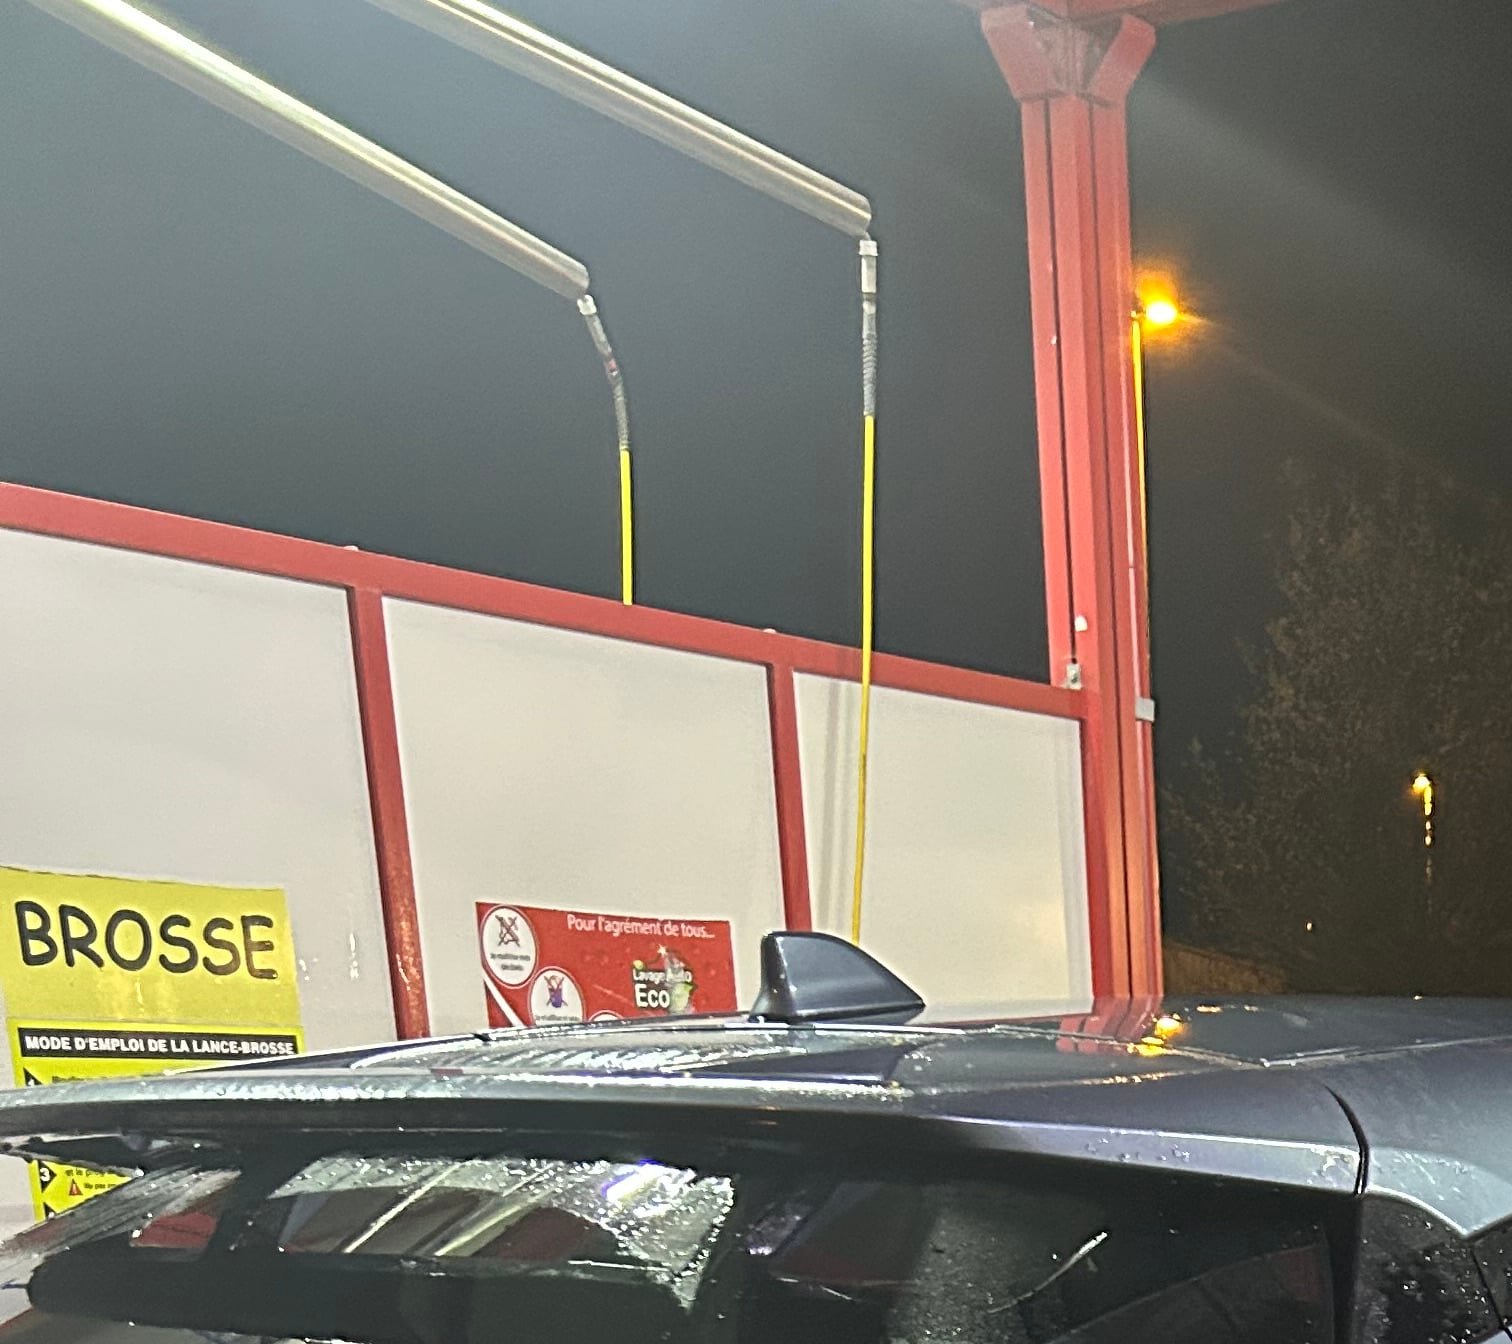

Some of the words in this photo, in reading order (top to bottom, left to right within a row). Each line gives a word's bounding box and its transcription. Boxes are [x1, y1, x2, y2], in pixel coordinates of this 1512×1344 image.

[567, 913, 596, 931] Pour
[664, 920, 679, 936] de
[15, 900, 279, 980] BROSSE
[634, 983, 671, 1008] Eco
[25, 1035, 70, 1050] MODE
[74, 1037, 144, 1052] D'EMPLOI
[148, 1039, 168, 1053] DE
[170, 1039, 190, 1054] LA
[193, 1039, 295, 1055] LANCE-BROSSE
[40, 1167, 51, 1182] 3
